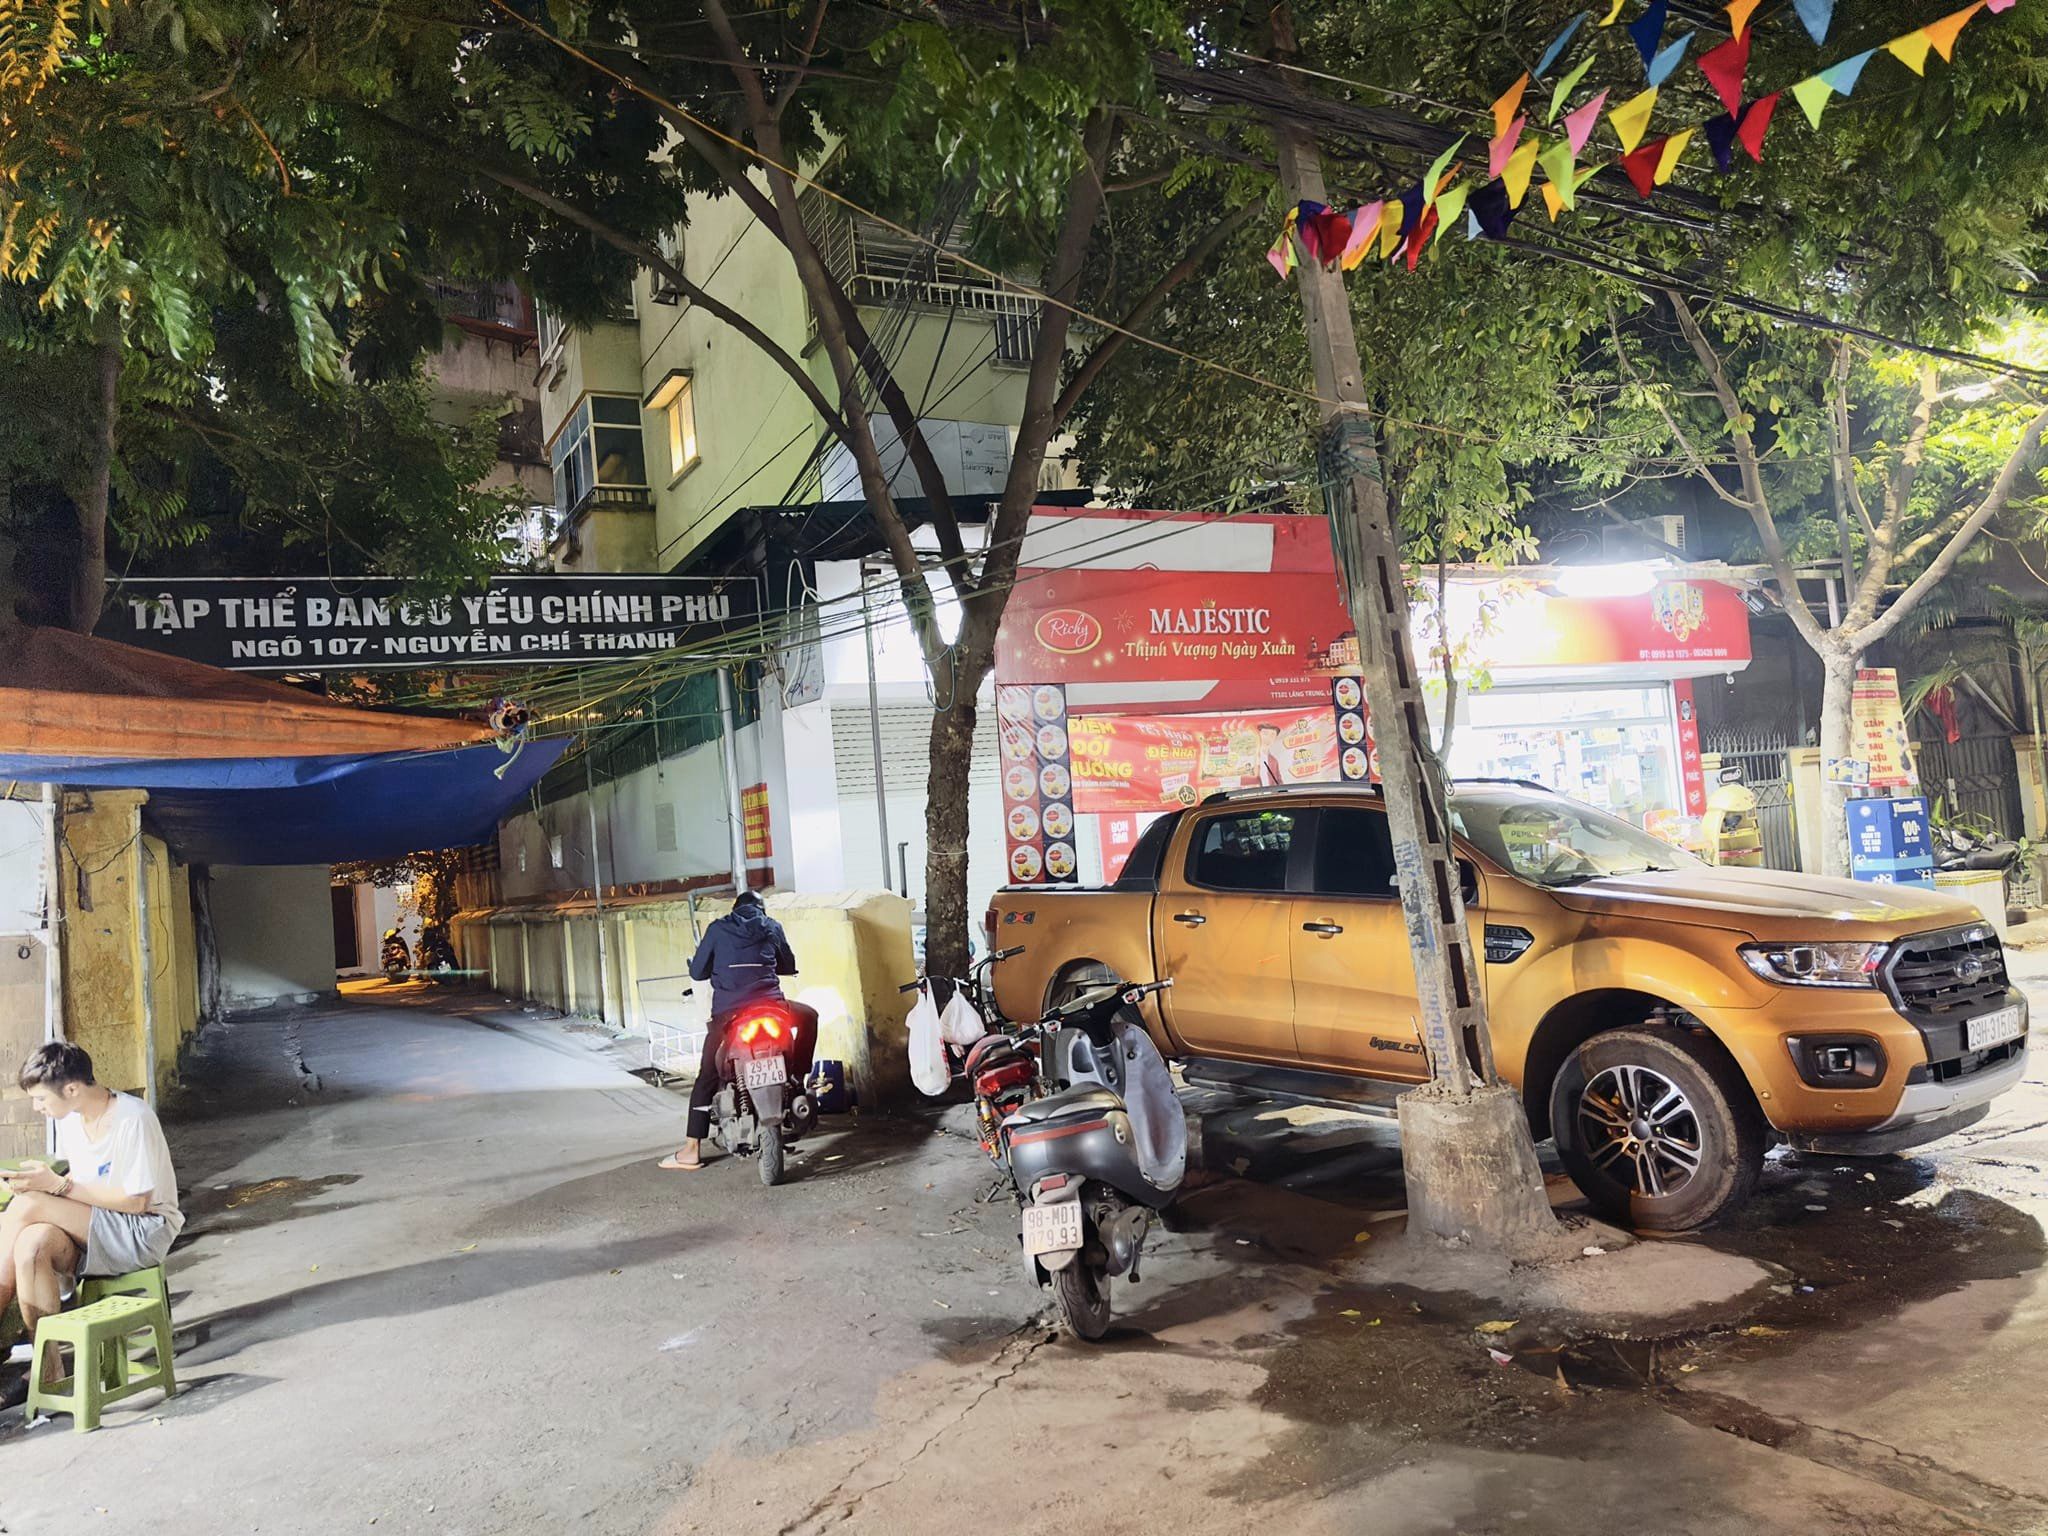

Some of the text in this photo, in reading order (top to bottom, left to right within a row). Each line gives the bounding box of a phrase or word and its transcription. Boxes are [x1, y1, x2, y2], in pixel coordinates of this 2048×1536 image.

[128, 592, 210, 635] TẬP
[217, 586, 297, 628] THỂ
[306, 597, 390, 627] BAN
[461, 587, 534, 625] YẾU
[541, 589, 652, 624] CHÍNH
[1149, 607, 1270, 635] MAJESTIC
[231, 635, 302, 658] NGÕ
[308, 638, 365, 655] 107
[384, 627, 512, 654] NGUYỄN
[520, 630, 570, 651] CHÍ
[579, 632, 676, 650] THANH
[1048, 614, 1089, 647] Richy
[1125, 637, 1297, 661] Thịnh Vượng Ngày Xuân
